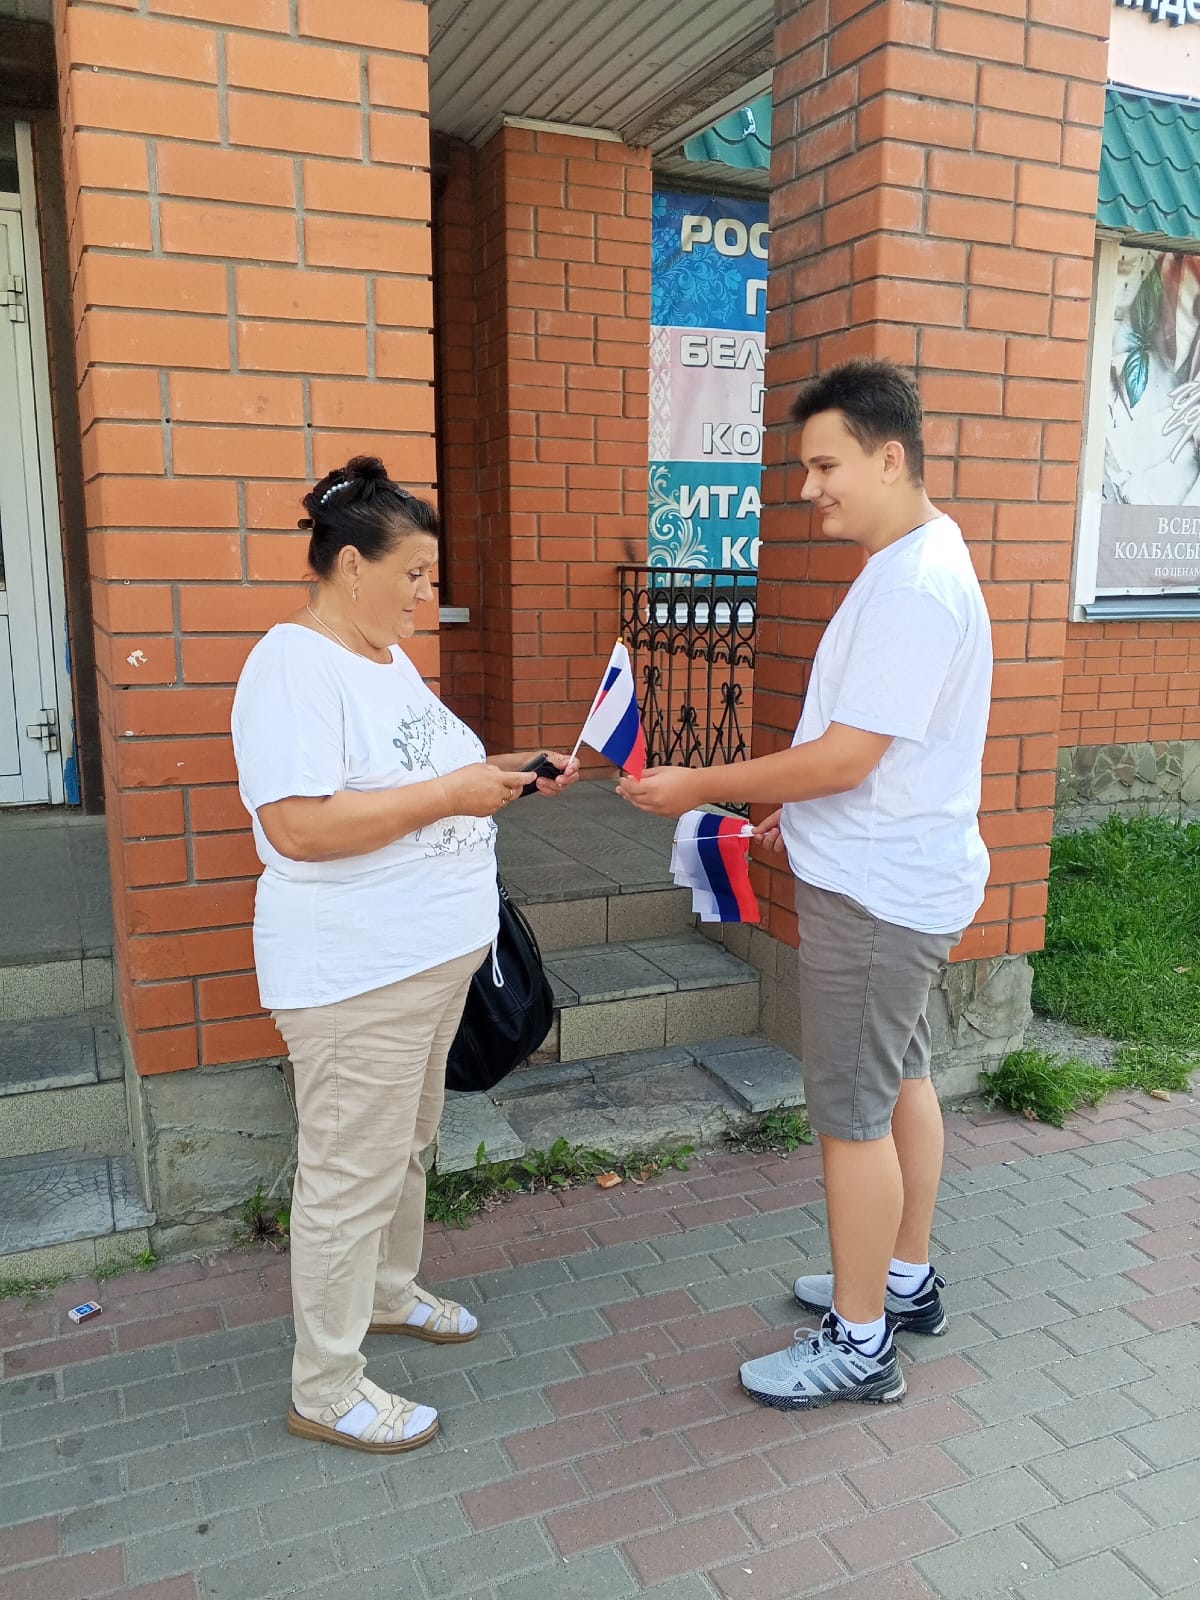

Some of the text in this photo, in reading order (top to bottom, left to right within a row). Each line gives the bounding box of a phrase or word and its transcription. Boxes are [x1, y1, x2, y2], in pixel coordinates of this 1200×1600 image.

[681, 214, 769, 259] РОС
[681, 335, 765, 371] БЕЛ
[703, 422, 761, 455] КО
[680, 485, 761, 519] ИТА
[1157, 516, 1200, 538] ВСЕГ
[722, 536, 760, 569] К
[1154, 567, 1169, 577] ПО
